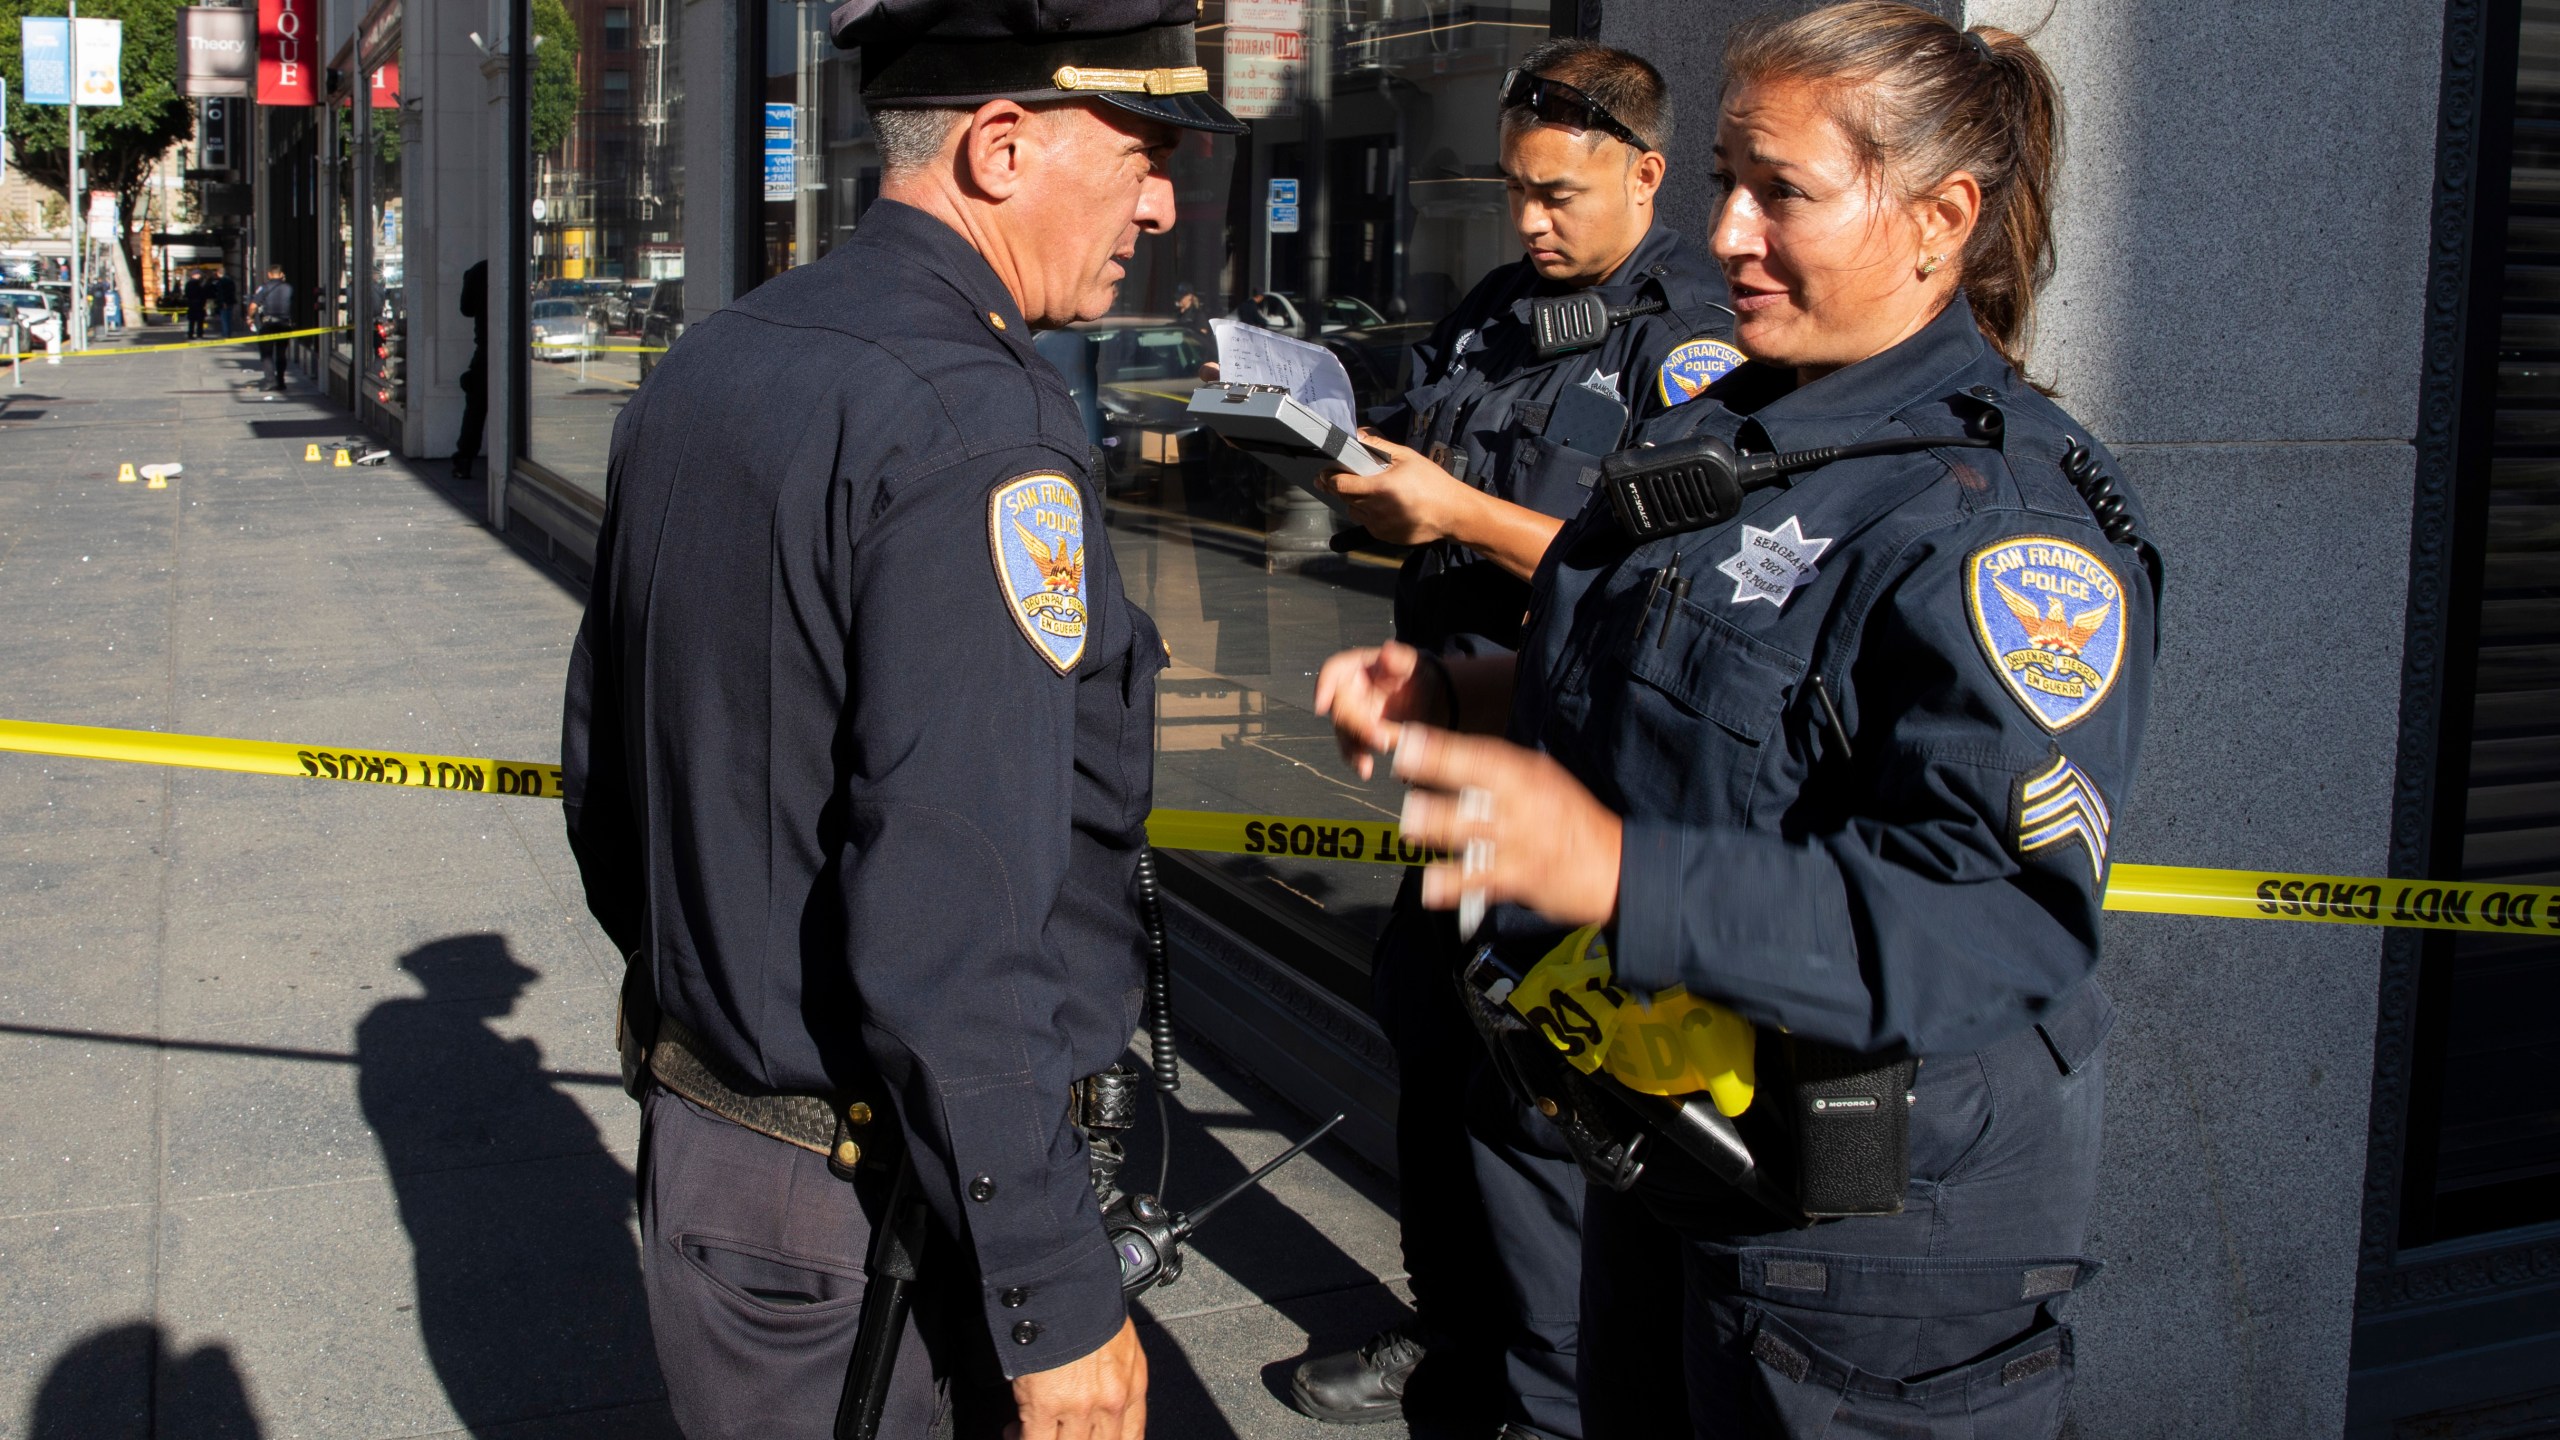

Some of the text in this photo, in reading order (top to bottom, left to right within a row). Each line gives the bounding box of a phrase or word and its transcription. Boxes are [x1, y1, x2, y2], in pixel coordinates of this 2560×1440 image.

[187, 35, 246, 53] Theory
[1543, 308, 1552, 343] MOTOROLA
[1665, 345, 1743, 371] SAN FRANCISCO
[1684, 360, 1726, 372] POLICE
[1005, 486, 1039, 517] SAN
[1036, 508, 1079, 537] POLICE
[1759, 557, 1785, 577] 2027
[1984, 547, 2117, 601] SAN FRANCISCO
[1749, 574, 1785, 594] POLICE
[2021, 570, 2090, 601] POLICE
[1041, 595, 1050, 604] EN
[1041, 618, 1081, 634] EN GUERRA
[2027, 652, 2038, 661] EN
[2063, 658, 2097, 681] FIERRO
[2027, 673, 2082, 695] EN GUERRA
[297, 750, 408, 785] CROSS
[416, 761, 485, 792] NOT
[496, 766, 543, 797] DO
[1244, 820, 1365, 859] CROSS
[2256, 879, 2382, 920] CROSS
[2390, 886, 2475, 925] NOT
[2480, 891, 2540, 928] DO
[1828, 1100, 1876, 1108] MOTOROLA
